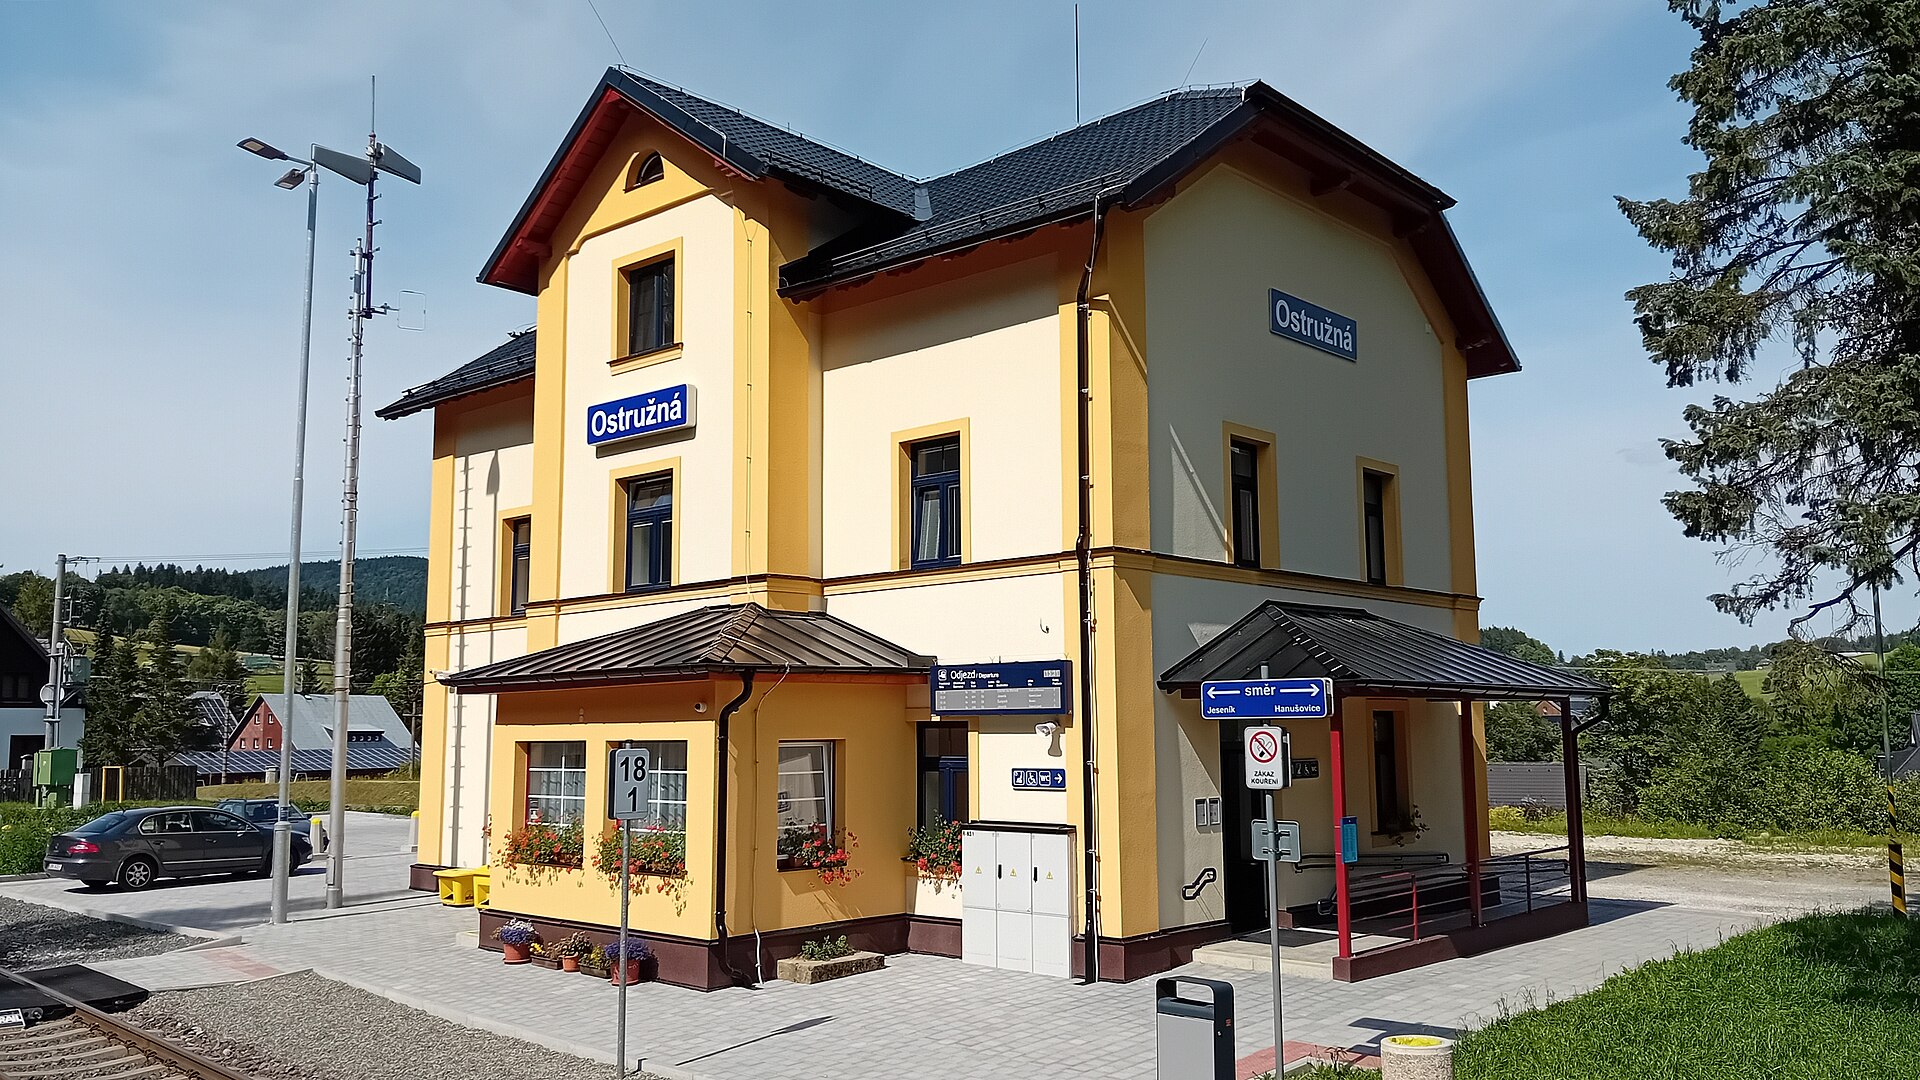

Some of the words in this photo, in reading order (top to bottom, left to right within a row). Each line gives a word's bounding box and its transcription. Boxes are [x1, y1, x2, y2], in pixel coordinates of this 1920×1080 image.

[1276, 300, 1352, 351] Ostružná
[591, 392, 682, 436] Ostružná
[950, 670, 976, 681] Odjezd
[1244, 683, 1276, 696] směr
[1207, 705, 1236, 714] Jeseník
[1274, 704, 1321, 713] Hanušovice
[619, 756, 647, 782] 18
[1253, 770, 1275, 778] ZÁKAZ
[1040, 774, 1050, 782] WC
[1250, 777, 1279, 785] KOUŘENÍ
[627, 786, 638, 812] 1
